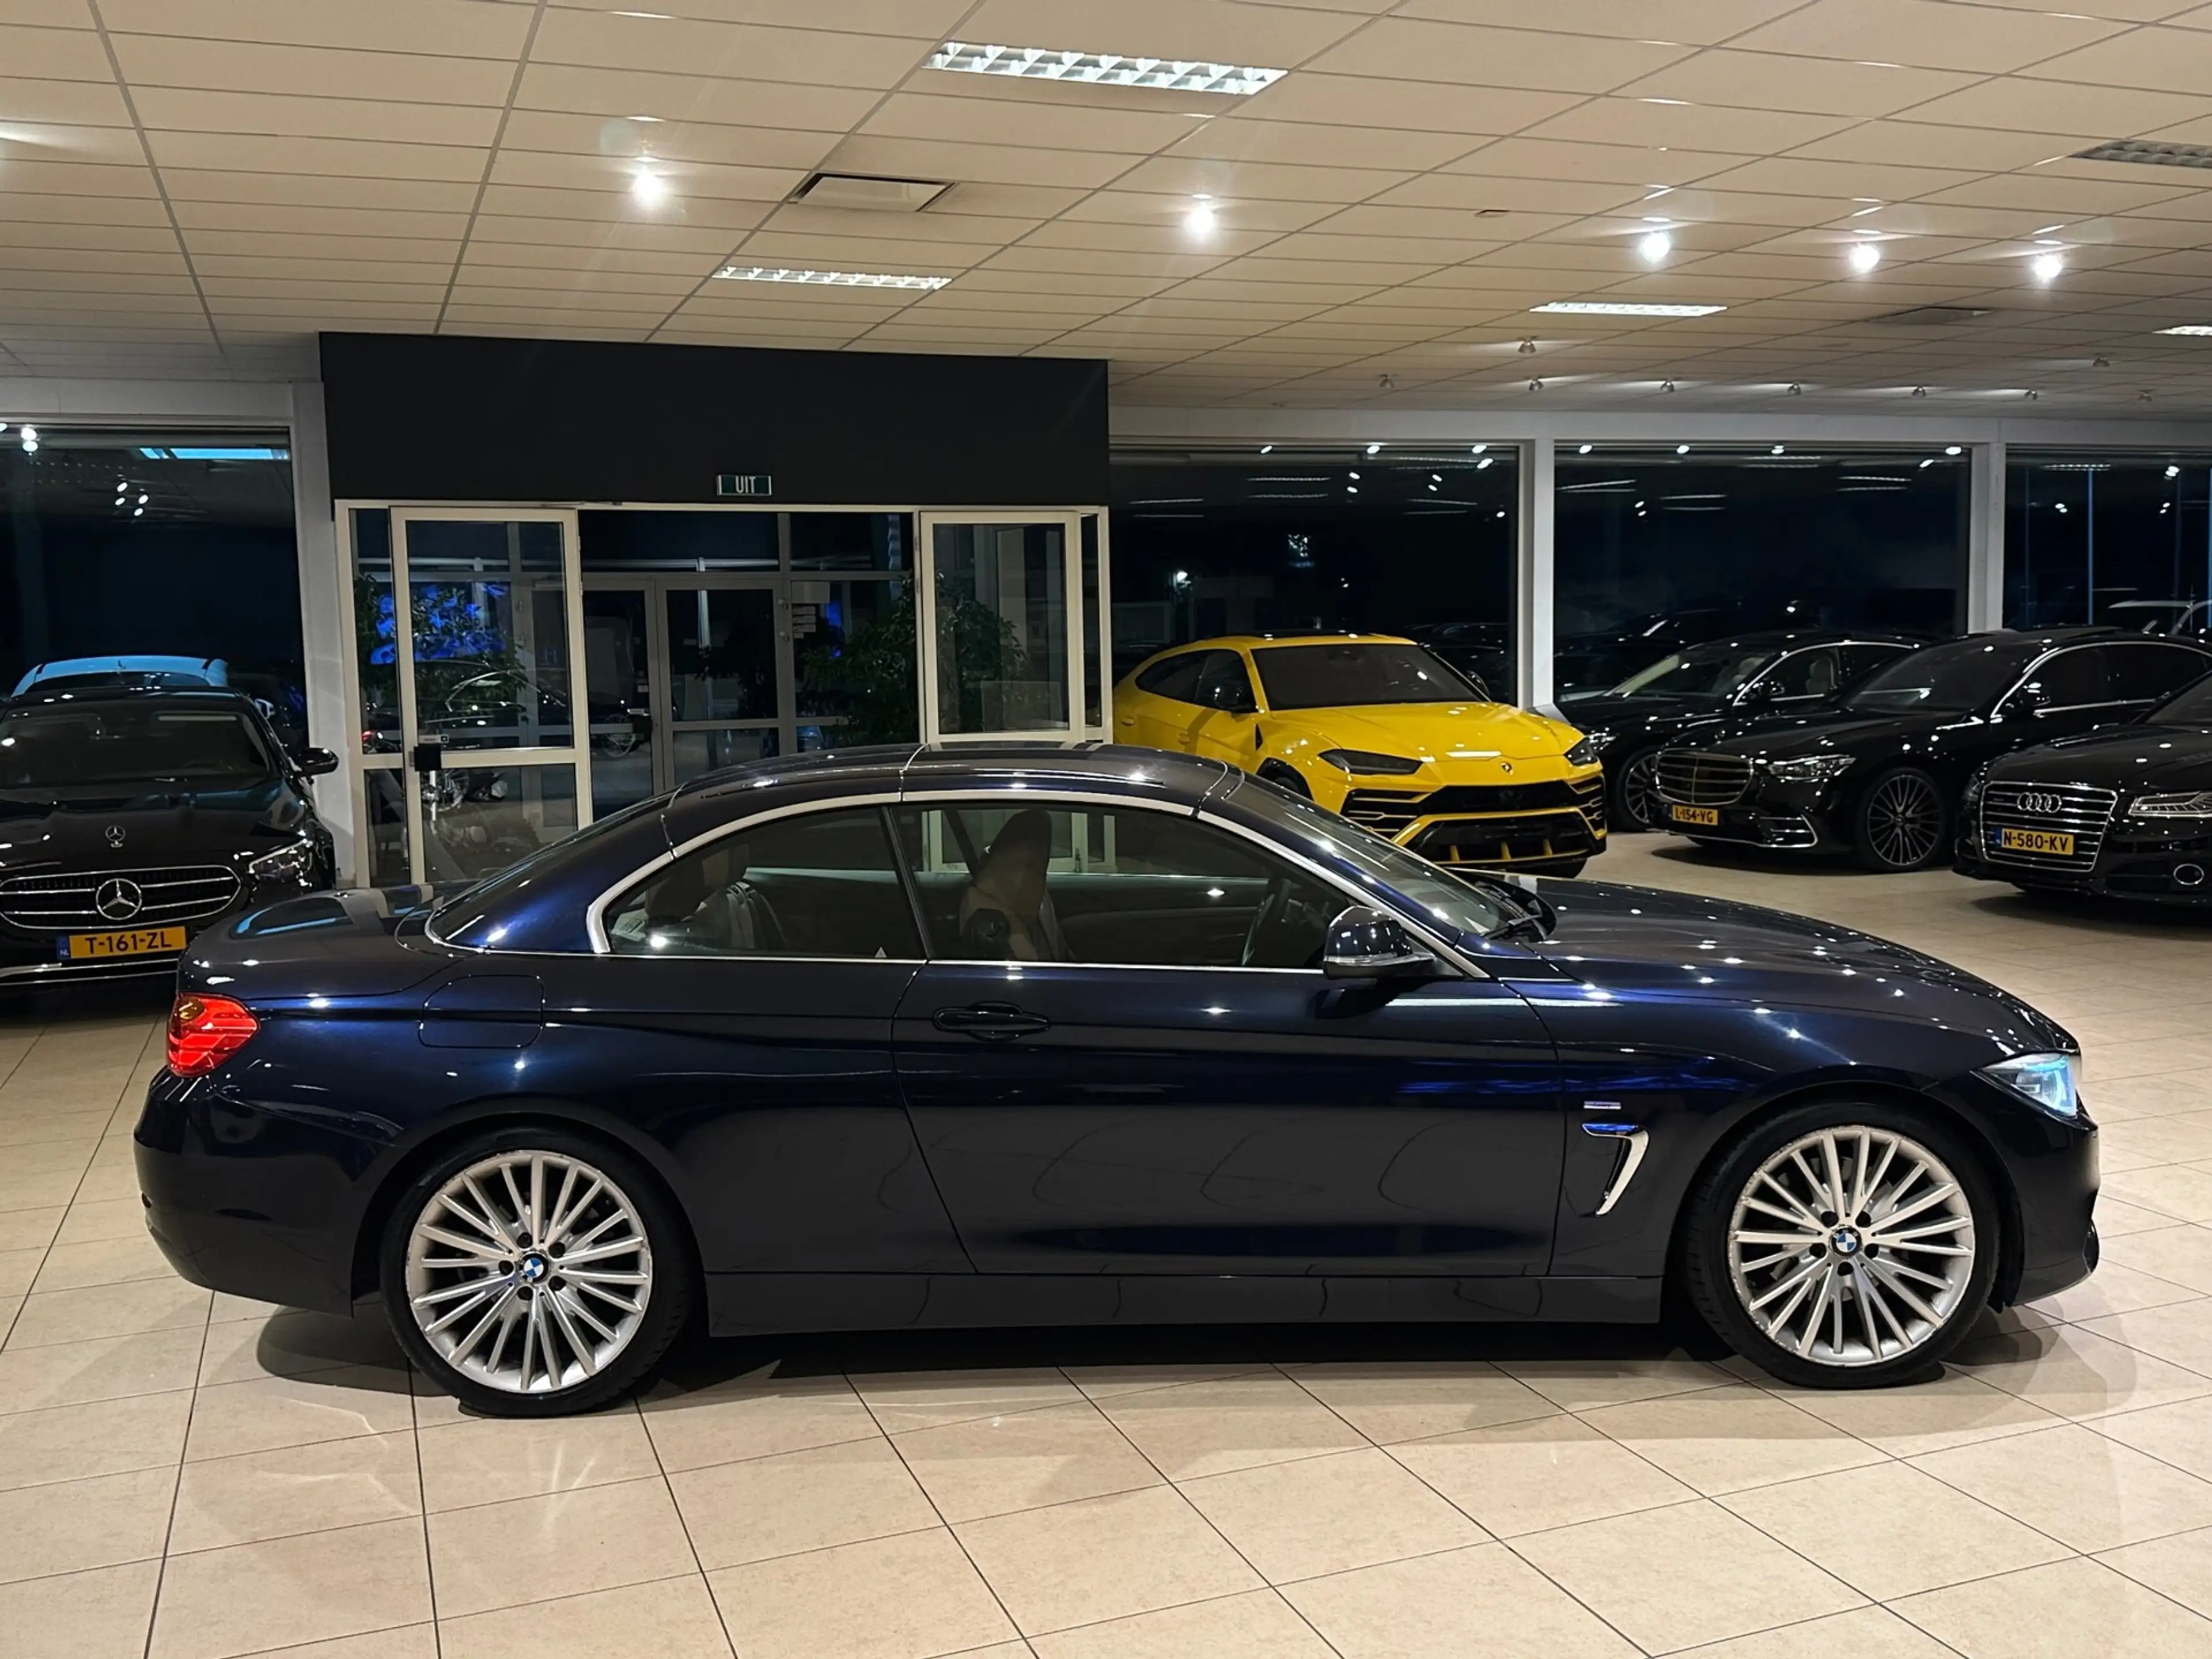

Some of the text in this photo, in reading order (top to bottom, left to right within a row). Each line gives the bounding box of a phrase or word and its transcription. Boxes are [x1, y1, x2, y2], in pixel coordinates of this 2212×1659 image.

[735, 475, 756, 494] UIT
[2003, 831, 2069, 851] N-580-KV
[85, 931, 172, 954] T-161-ZL
